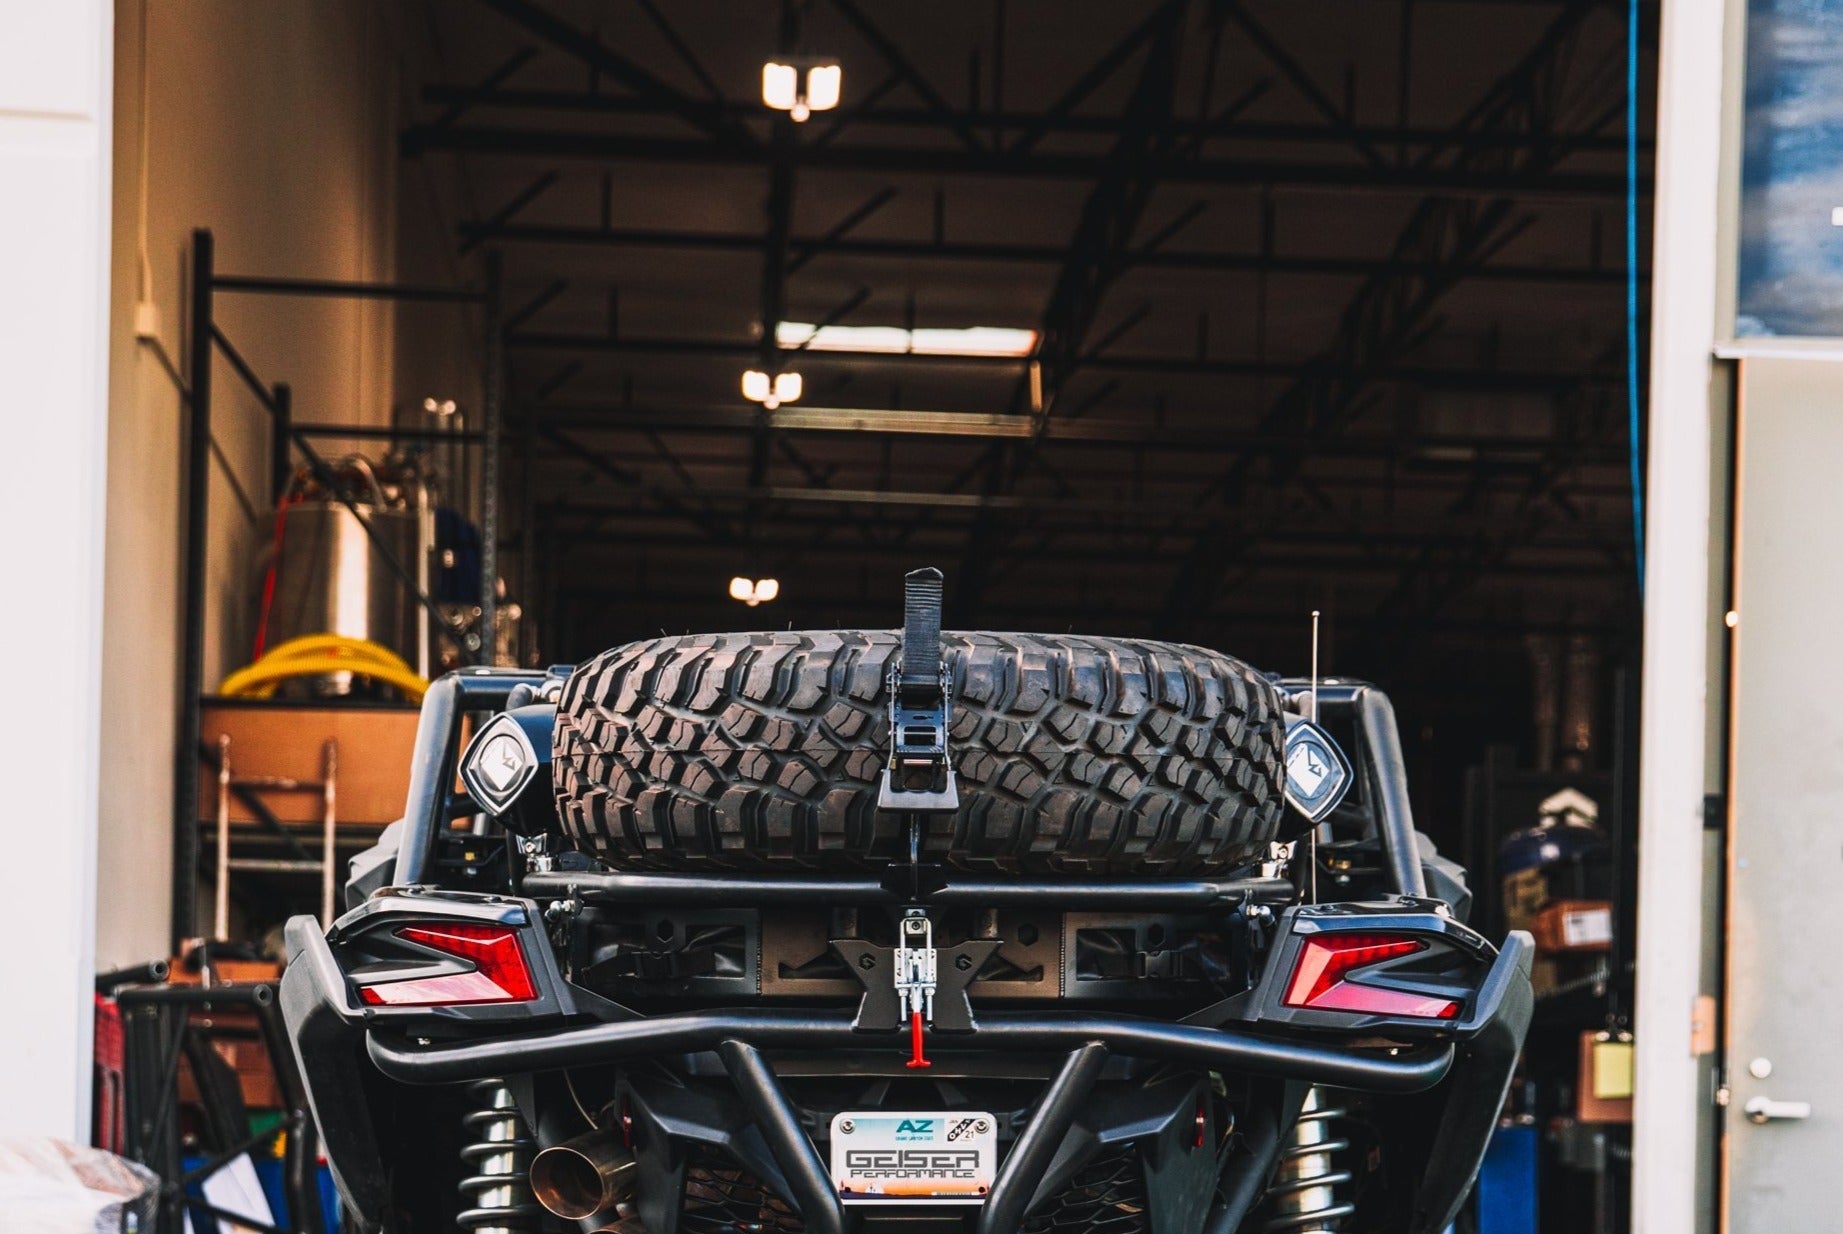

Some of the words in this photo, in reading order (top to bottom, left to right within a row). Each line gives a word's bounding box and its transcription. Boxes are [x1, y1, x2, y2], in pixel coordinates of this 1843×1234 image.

[896, 1120, 933, 1133] AZ
[965, 1130, 974, 1139] 21
[846, 1150, 979, 1168] GEISER
[850, 1169, 975, 1178] PERFORMANCE
